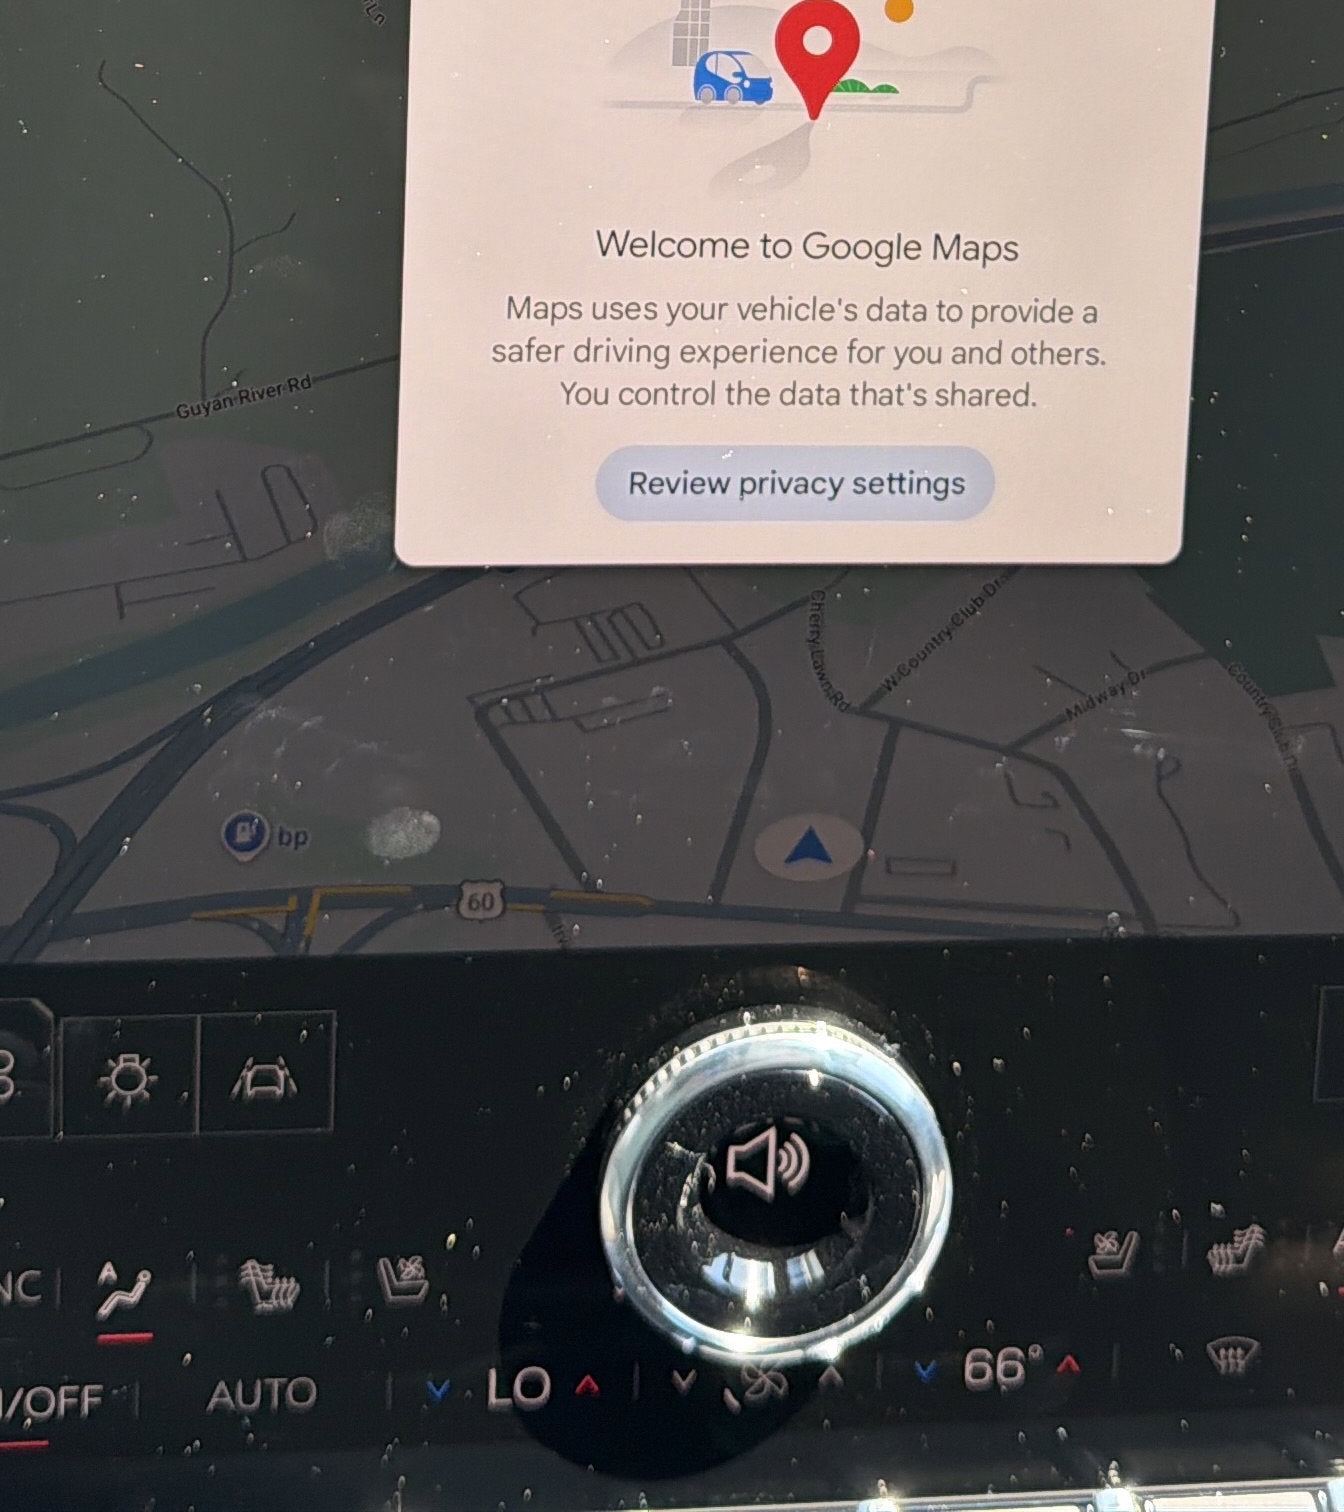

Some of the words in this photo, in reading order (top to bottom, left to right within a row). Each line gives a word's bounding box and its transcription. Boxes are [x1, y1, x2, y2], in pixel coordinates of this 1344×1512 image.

[596, 229, 750, 259] Welcome
[760, 232, 793, 260] to
[802, 231, 922, 268] Google
[932, 232, 1019, 270] Maps
[507, 295, 583, 327] Maps
[591, 301, 658, 321] uses
[665, 301, 729, 328] your
[736, 294, 858, 322] vehicle's
[866, 295, 928, 323] data
[936, 299, 964, 323] to
[970, 297, 1074, 329] provide
[1082, 305, 1098, 325] a
[491, 335, 566, 363] safer
[573, 336, 670, 370] driving
[679, 337, 838, 371] experience
[846, 337, 886, 365] for
[892, 345, 943, 371] you
[951, 339, 1003, 366] and
[1010, 339, 1106, 366] others.
[175, 394, 235, 420] Guyan
[237, 384, 284, 407] River
[285, 374, 313, 394] Rd
[560, 381, 610, 406] You
[618, 379, 716, 406] control
[724, 379, 771, 407] the
[779, 379, 841, 407] data
[849, 380, 928, 407] that's
[934, 380, 1037, 408] shared.
[629, 469, 732, 496] Review
[739, 469, 845, 502] privacy
[852, 469, 966, 502] settings
[807, 589, 826, 646] Cherry
[896, 622, 956, 679] Country
[950, 595, 986, 629] Club
[982, 576, 1005, 599] Dr
[810, 647, 835, 697] Lawn
[828, 689, 851, 712] Rd
[1064, 679, 1127, 722] Midway
[1126, 669, 1147, 686] Dr
[277, 825, 309, 851] bp
[467, 892, 496, 912] 60
[963, 1343, 1045, 1390] 66°
[206, 1376, 318, 1414] AUTO
[487, 1365, 552, 1412] LO
